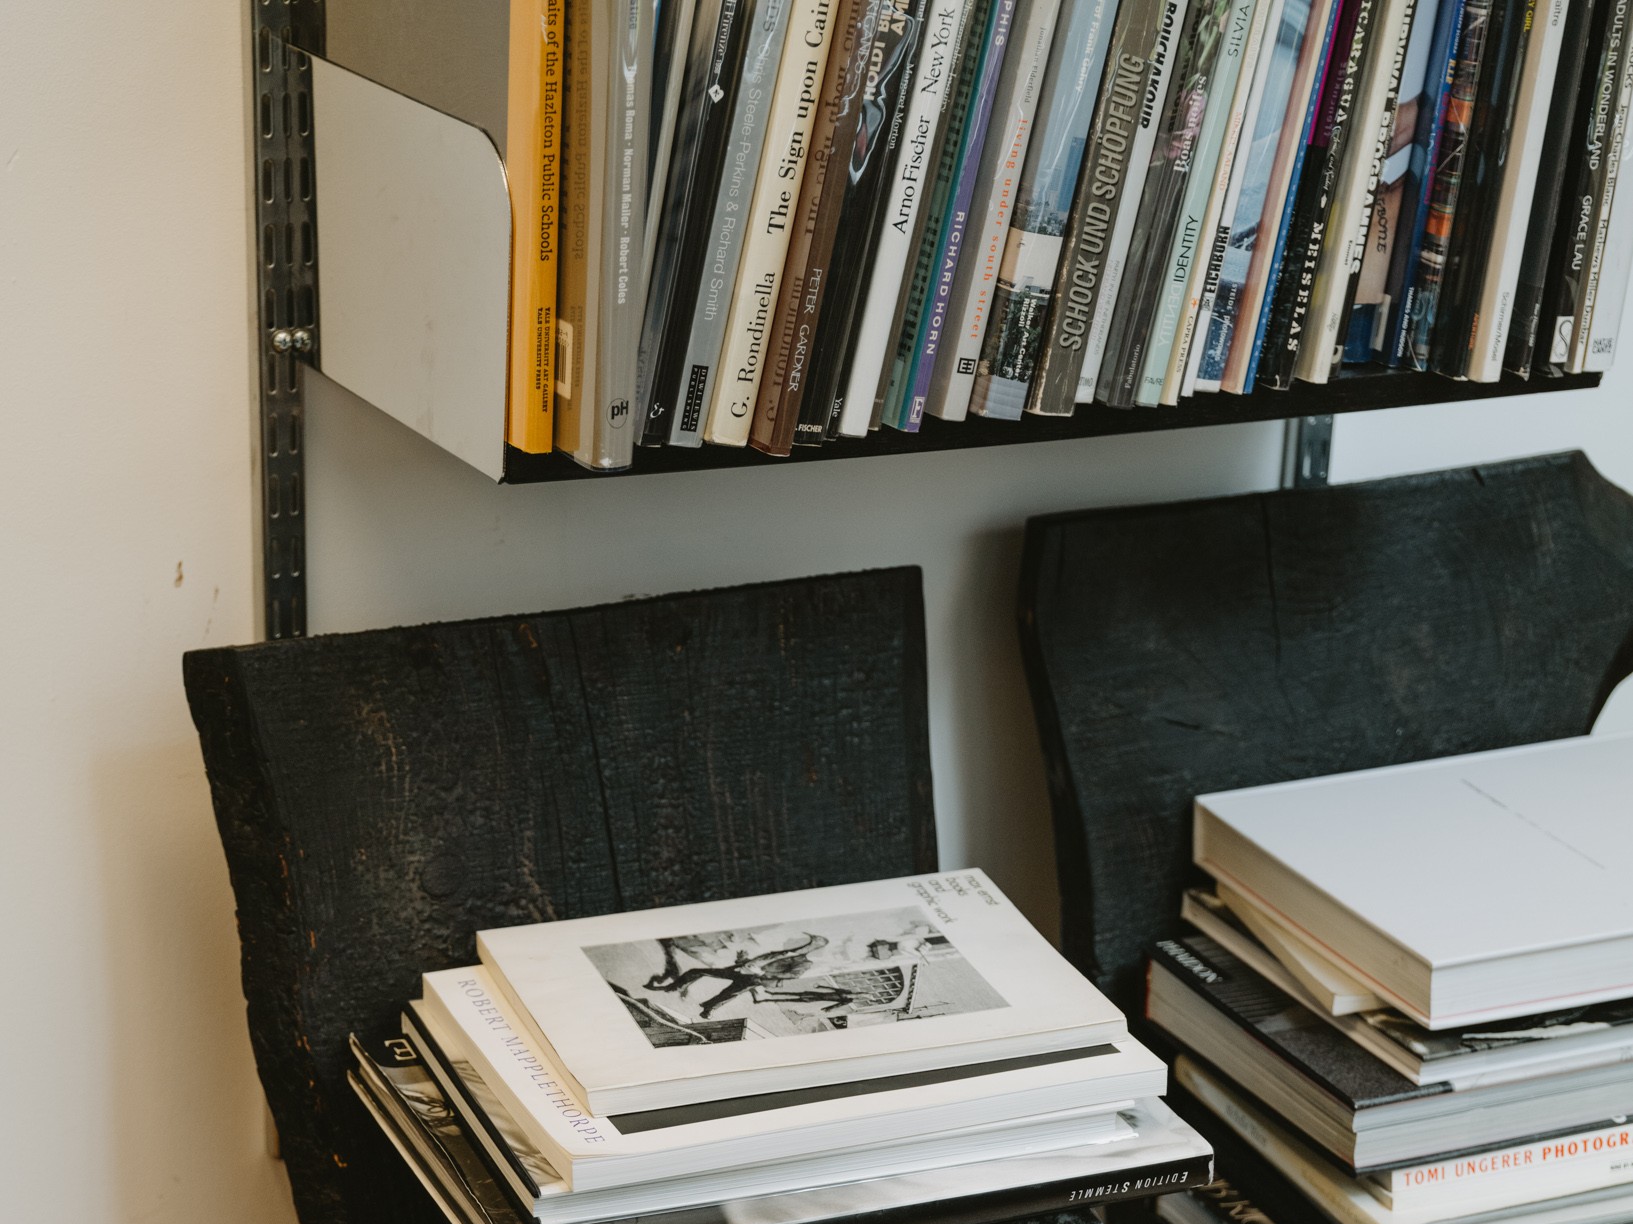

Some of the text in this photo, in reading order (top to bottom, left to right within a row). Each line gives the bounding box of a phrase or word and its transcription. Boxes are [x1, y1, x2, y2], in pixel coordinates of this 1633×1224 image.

[1086, 20, 1100, 55] Frank
[1523, 10, 1534, 33] GIRL
[863, 40, 886, 101] HOLDT
[1024, 65, 1039, 104] Elderfield
[1607, 51, 1618, 64] IN
[624, 109, 636, 141] Roma
[888, 62, 916, 150] Margaret Morton
[891, 8, 956, 235] Arno Fischer New York
[1091, 52, 1146, 200] SCHÖPFUNG
[1589, 68, 1615, 170] WONDERLAND
[539, 30, 560, 261] of the Hazleton Public Schools
[729, 88, 762, 197] Steele-Perkins
[1172, 4, 1251, 283] IDENTITY SILVIA
[622, 148, 634, 192] Norman
[620, 194, 632, 230] Mailer
[726, 201, 739, 213] &
[970, 119, 1028, 340] living under south street
[1079, 202, 1112, 256] UND
[1574, 195, 1593, 240] GRACE
[618, 237, 631, 274] Robert
[713, 217, 736, 274] Richard
[730, 60, 819, 419] G. Rondinella The Sign upon
[1204, 225, 1231, 294] EICHBORN
[1570, 243, 1586, 271] LAU
[617, 275, 629, 305] Coles
[704, 278, 724, 321] Smith
[926, 210, 966, 356] RICHARD HORN
[1059, 254, 1101, 351] SCHOCK
[1286, 221, 1325, 352] MEISELAS
[787, 267, 823, 393] PETER GARDNER
[1013, 298, 1037, 378] Walker Art Center
[1018, 298, 1030, 328] Rizzoli
[542, 326, 550, 368] UNIVERSITY
[1124, 343, 1141, 390] Fabulatorio
[1176, 315, 1194, 374] CAPRA PRESS
[682, 368, 698, 430] PUBLISHING
[831, 397, 844, 418] Yale
[798, 423, 823, 434] FISCHER
[457, 978, 605, 1145] ROBERT MAPPLETHORPE
[1069, 1171, 1189, 1201] EDITION STEMMLE
[1403, 1167, 1446, 1187] TOMI
[1455, 1150, 1534, 1178] UNGERER
